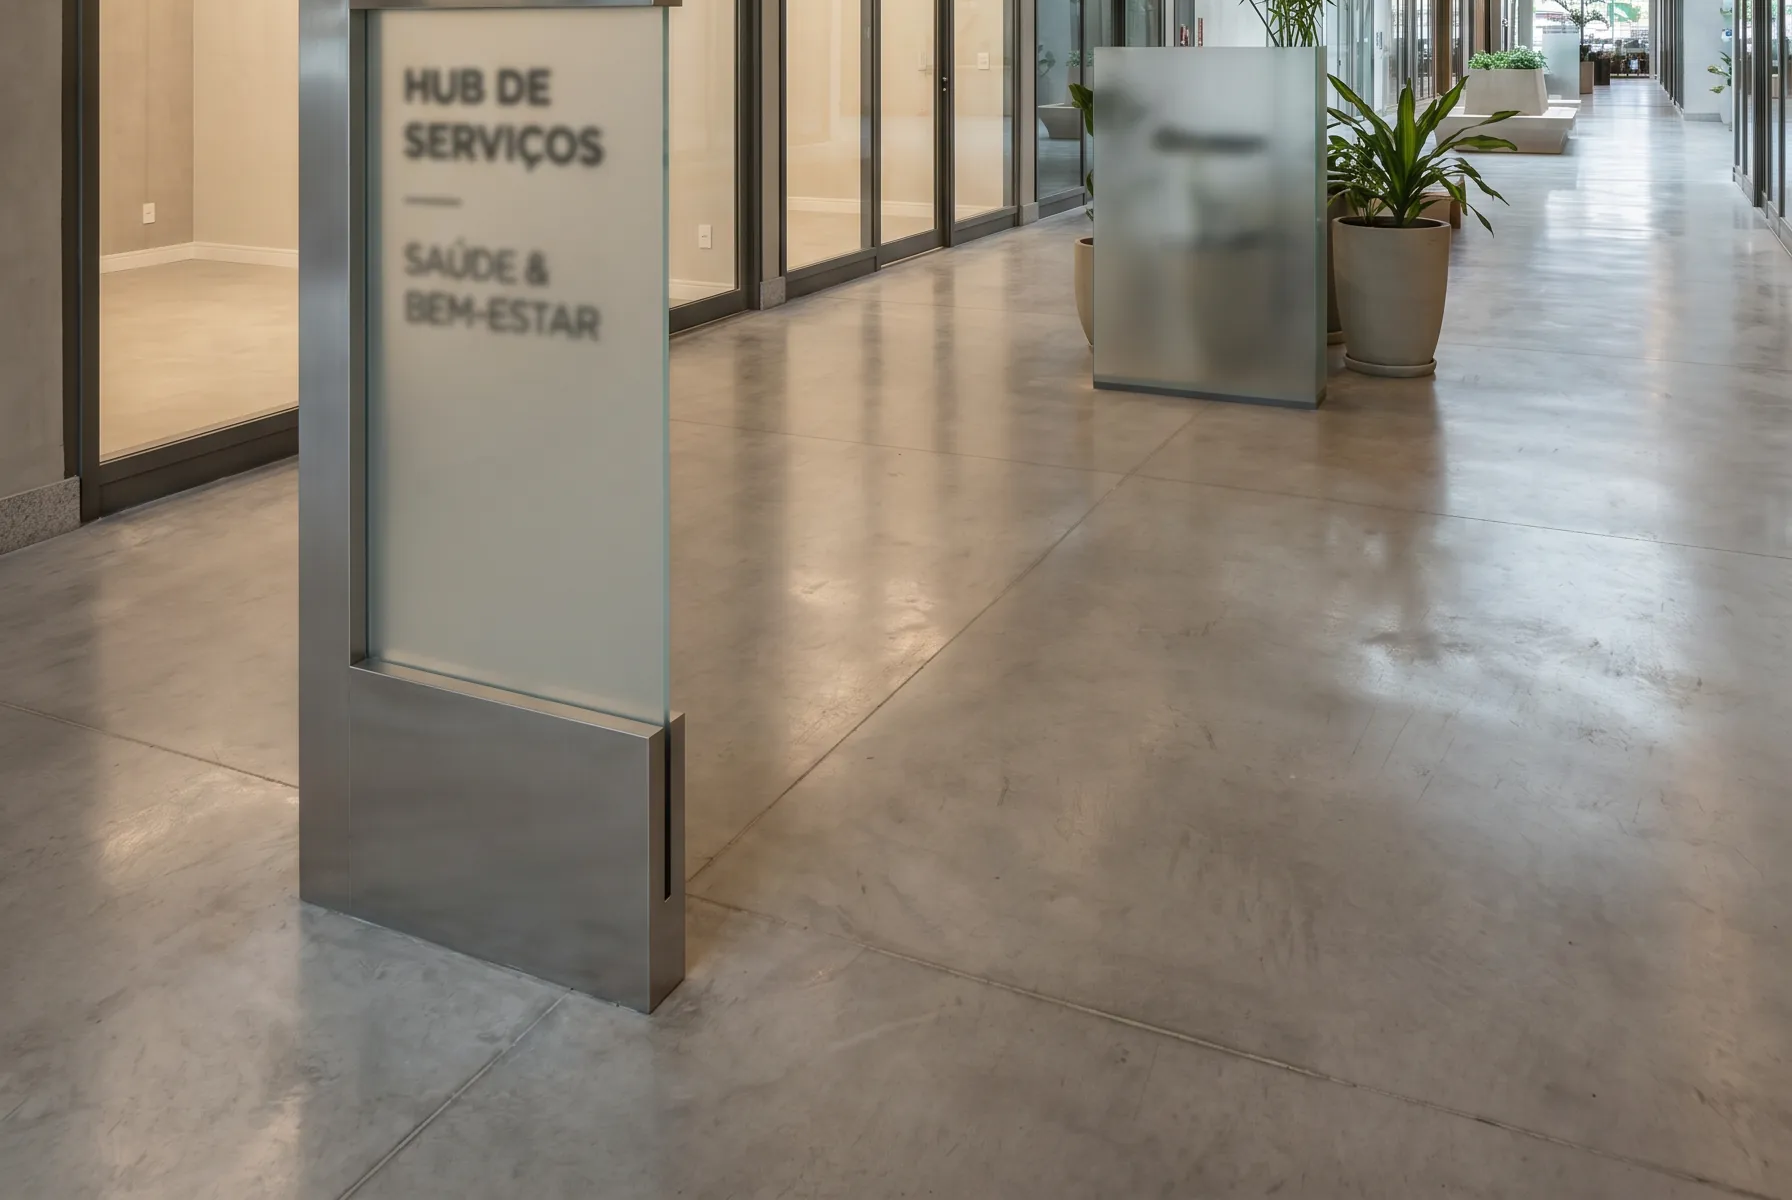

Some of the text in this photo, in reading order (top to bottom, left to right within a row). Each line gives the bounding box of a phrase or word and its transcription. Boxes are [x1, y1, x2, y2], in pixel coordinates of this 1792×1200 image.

[404, 67, 553, 107] HUB DE
[403, 122, 606, 172] SERVIÇOS
[404, 237, 550, 287] SAÚDE &
[403, 289, 602, 342] BEM-ESTAR
